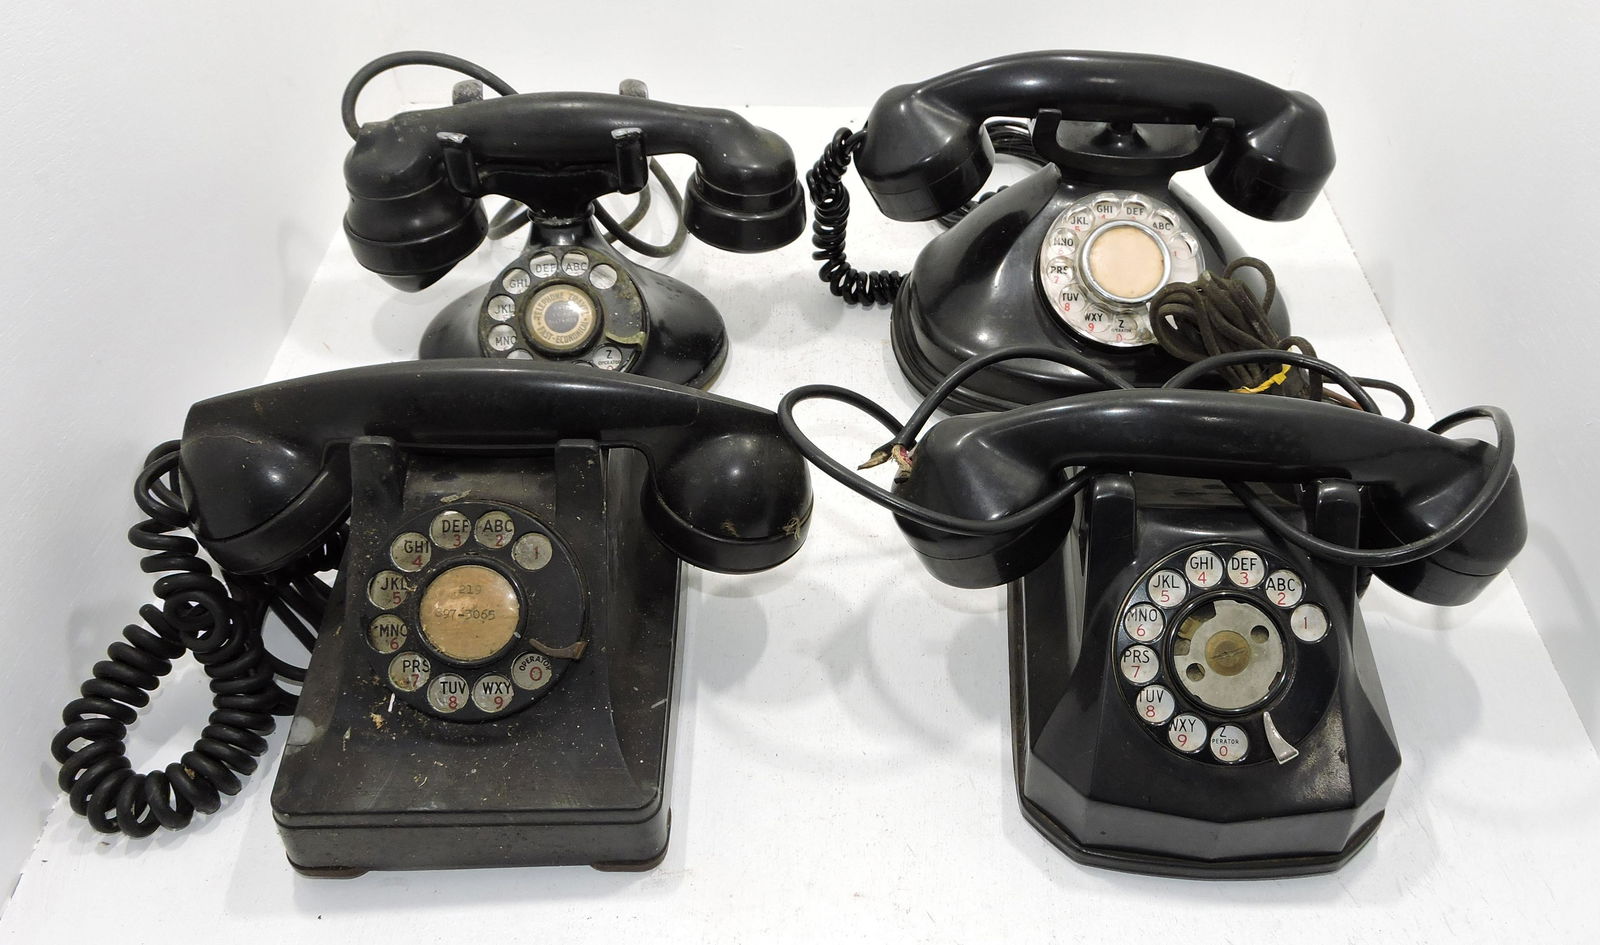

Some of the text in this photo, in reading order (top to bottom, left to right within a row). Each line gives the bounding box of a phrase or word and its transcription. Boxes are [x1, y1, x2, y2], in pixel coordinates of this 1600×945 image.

[1096, 204, 1113, 213] GHI
[1126, 207, 1144, 216] DEF
[1070, 216, 1089, 225] JKL
[1152, 222, 1171, 231] ABC
[535, 263, 556, 273] DEF
[565, 262, 587, 272] ABC
[1050, 265, 1069, 275] PRS
[1062, 293, 1079, 301] TUV
[495, 304, 516, 315] JKL
[1064, 302, 1071, 312] 8
[1084, 312, 1103, 322] WXY
[1118, 319, 1125, 328] Z
[1088, 322, 1095, 331] 9
[495, 335, 517, 346] MNO
[606, 349, 613, 360] Z
[442, 519, 469, 533] DEF
[482, 519, 513, 533] ABC
[404, 540, 429, 553] GHI
[453, 534, 462, 547] 3
[495, 534, 503, 547] 2
[534, 546, 539, 560] 1
[412, 555, 423, 567] 4
[1189, 556, 1214, 570] GHI
[1231, 557, 1258, 571] DEF
[380, 577, 407, 591] JKL
[1153, 574, 1180, 589] JKL
[1197, 571, 1207, 584] 4
[1239, 572, 1249, 585] 3
[1265, 577, 1296, 592] ABC
[392, 591, 402, 605] 5
[1160, 590, 1170, 603] 5
[1277, 592, 1286, 605] 2
[1127, 608, 1158, 622] MNO
[1303, 616, 1308, 630] 1
[379, 624, 408, 637] MNO
[1136, 623, 1146, 637] 6
[390, 638, 399, 650] 6
[1123, 649, 1150, 664] PRS
[402, 659, 431, 673] PRS
[519, 655, 552, 672] OPERATOR
[1131, 665, 1140, 679] 7
[411, 673, 420, 687] 7
[440, 681, 467, 695] TUV
[482, 681, 511, 695] WXY
[448, 695, 458, 710] 8
[1139, 689, 1165, 703] TUV
[494, 696, 503, 710] 9
[1145, 704, 1156, 718] 8
[1219, 725, 1227, 738] Z
[1177, 733, 1188, 747] 9
[1219, 745, 1228, 757] 0
